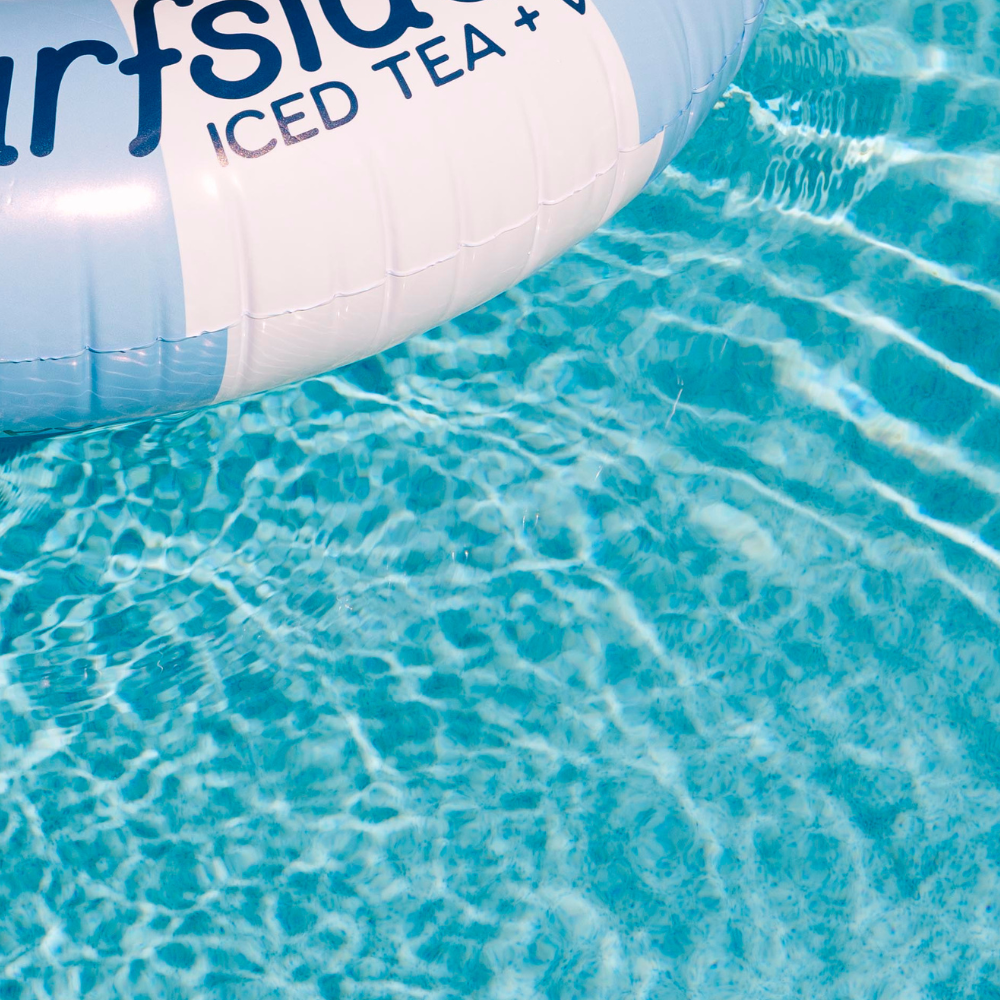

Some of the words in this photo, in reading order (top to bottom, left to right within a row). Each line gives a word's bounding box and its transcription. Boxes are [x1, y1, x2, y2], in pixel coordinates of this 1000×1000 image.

[206, 80, 359, 168] ICED
[371, 23, 506, 100] TEA
[514, 5, 540, 32] +
